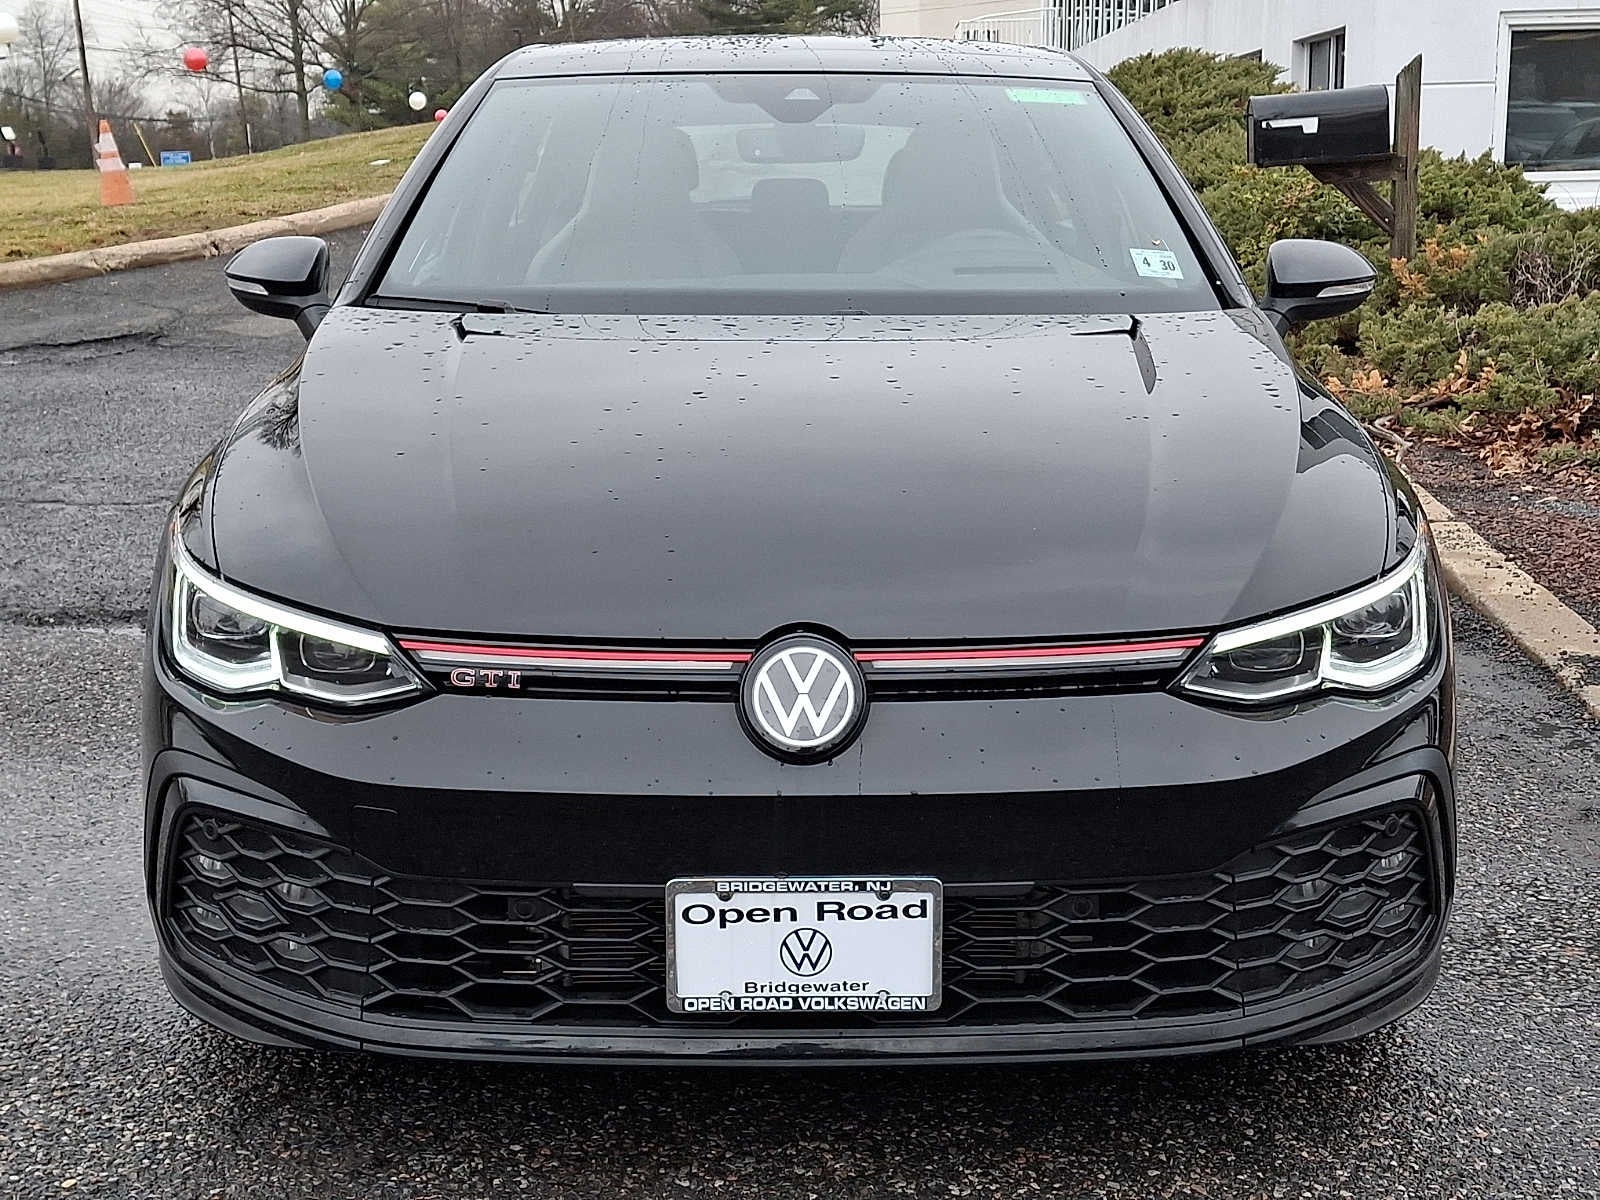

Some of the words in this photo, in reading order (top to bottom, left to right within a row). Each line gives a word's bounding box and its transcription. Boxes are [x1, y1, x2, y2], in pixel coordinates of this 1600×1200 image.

[1142, 256, 1151, 267] 4
[1160, 259, 1176, 271] 30
[450, 668, 521, 689] GTI
[757, 648, 851, 742] VW
[716, 881, 859, 892] BRIDGEWATER,
[866, 881, 892, 891] NJ
[681, 903, 798, 929] Open
[816, 899, 928, 922] Road
[781, 928, 831, 975] VW
[744, 981, 870, 995] Bridgewater
[684, 997, 735, 1011] OPEN
[740, 998, 793, 1010] ROAD
[798, 997, 926, 1010] VOLKSWAGEN
